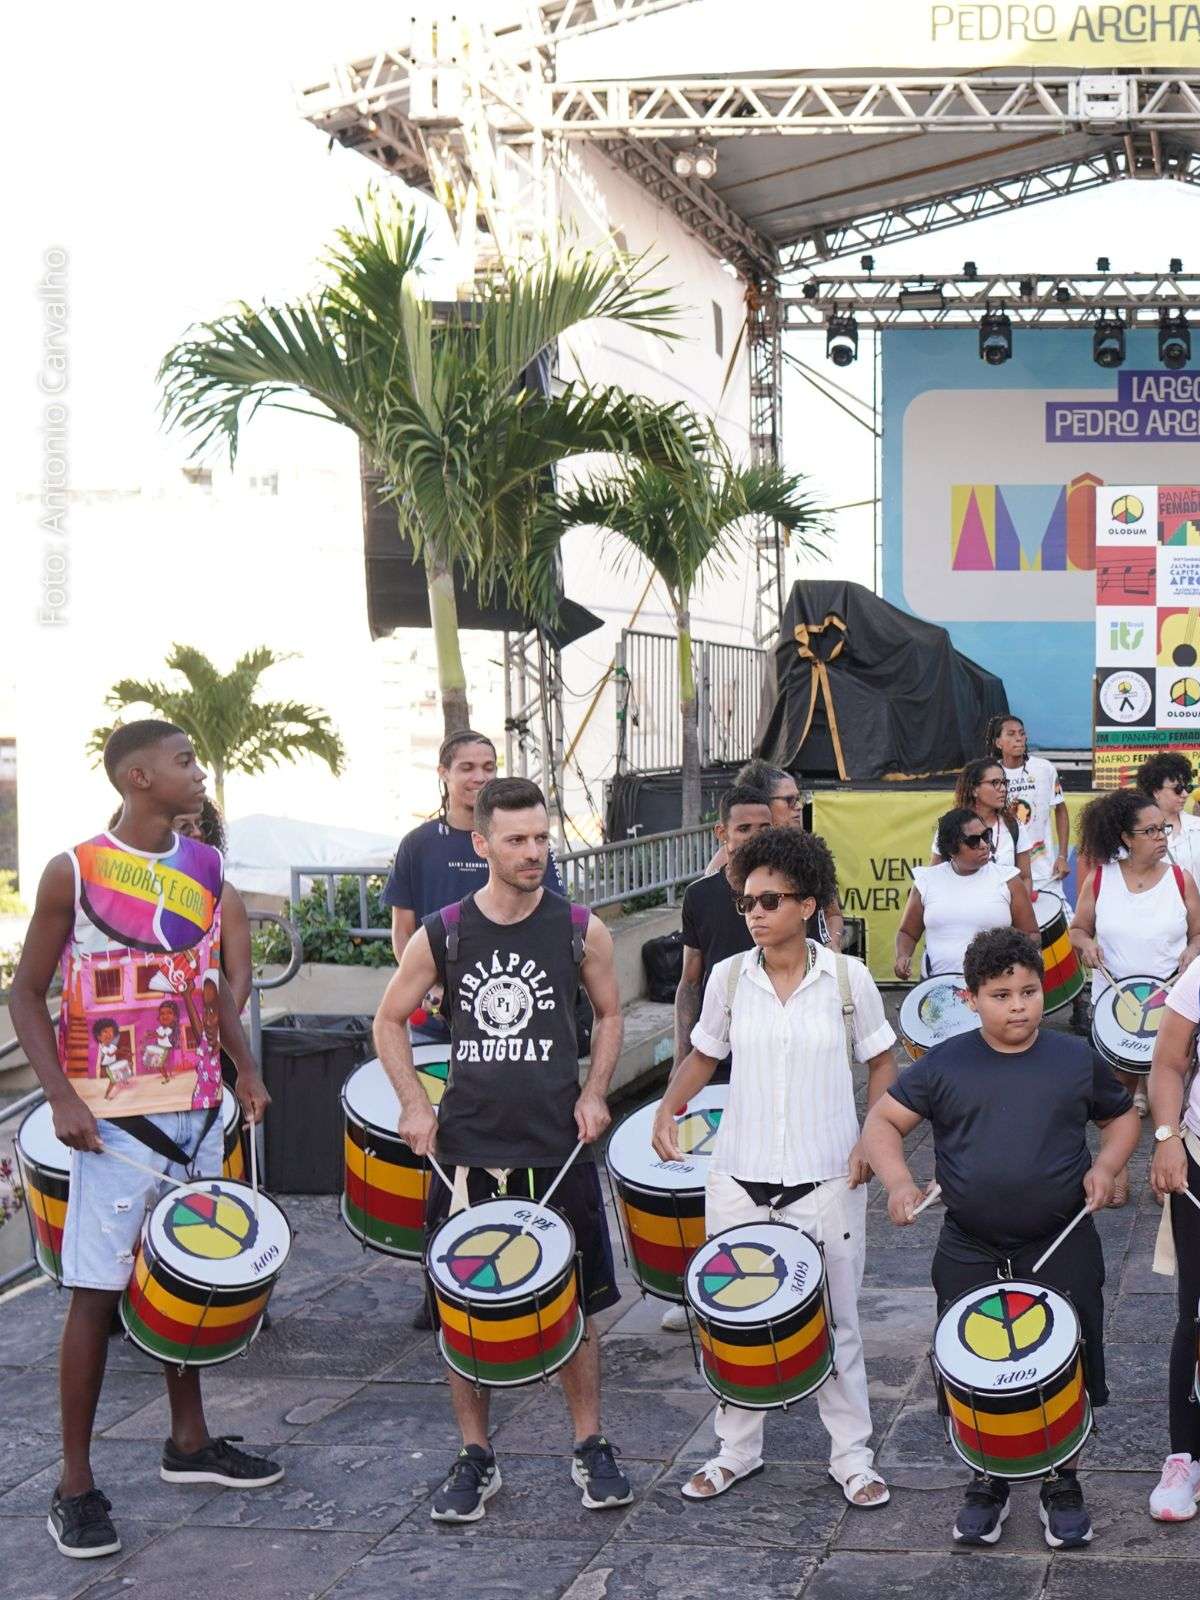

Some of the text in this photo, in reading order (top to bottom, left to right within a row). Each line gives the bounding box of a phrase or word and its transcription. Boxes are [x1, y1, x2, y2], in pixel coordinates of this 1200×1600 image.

[931, 4, 1056, 42] PEDRO
[1055, 408, 1139, 436] PEDRO
[1122, 732, 1167, 742] PANAFRO
[169, 878, 179, 901] E
[456, 1038, 554, 1062] URUGUAY
[250, 1244, 280, 1274] GOPE
[791, 1261, 809, 1296] GOPE
[992, 1367, 1037, 1386] GOPE
